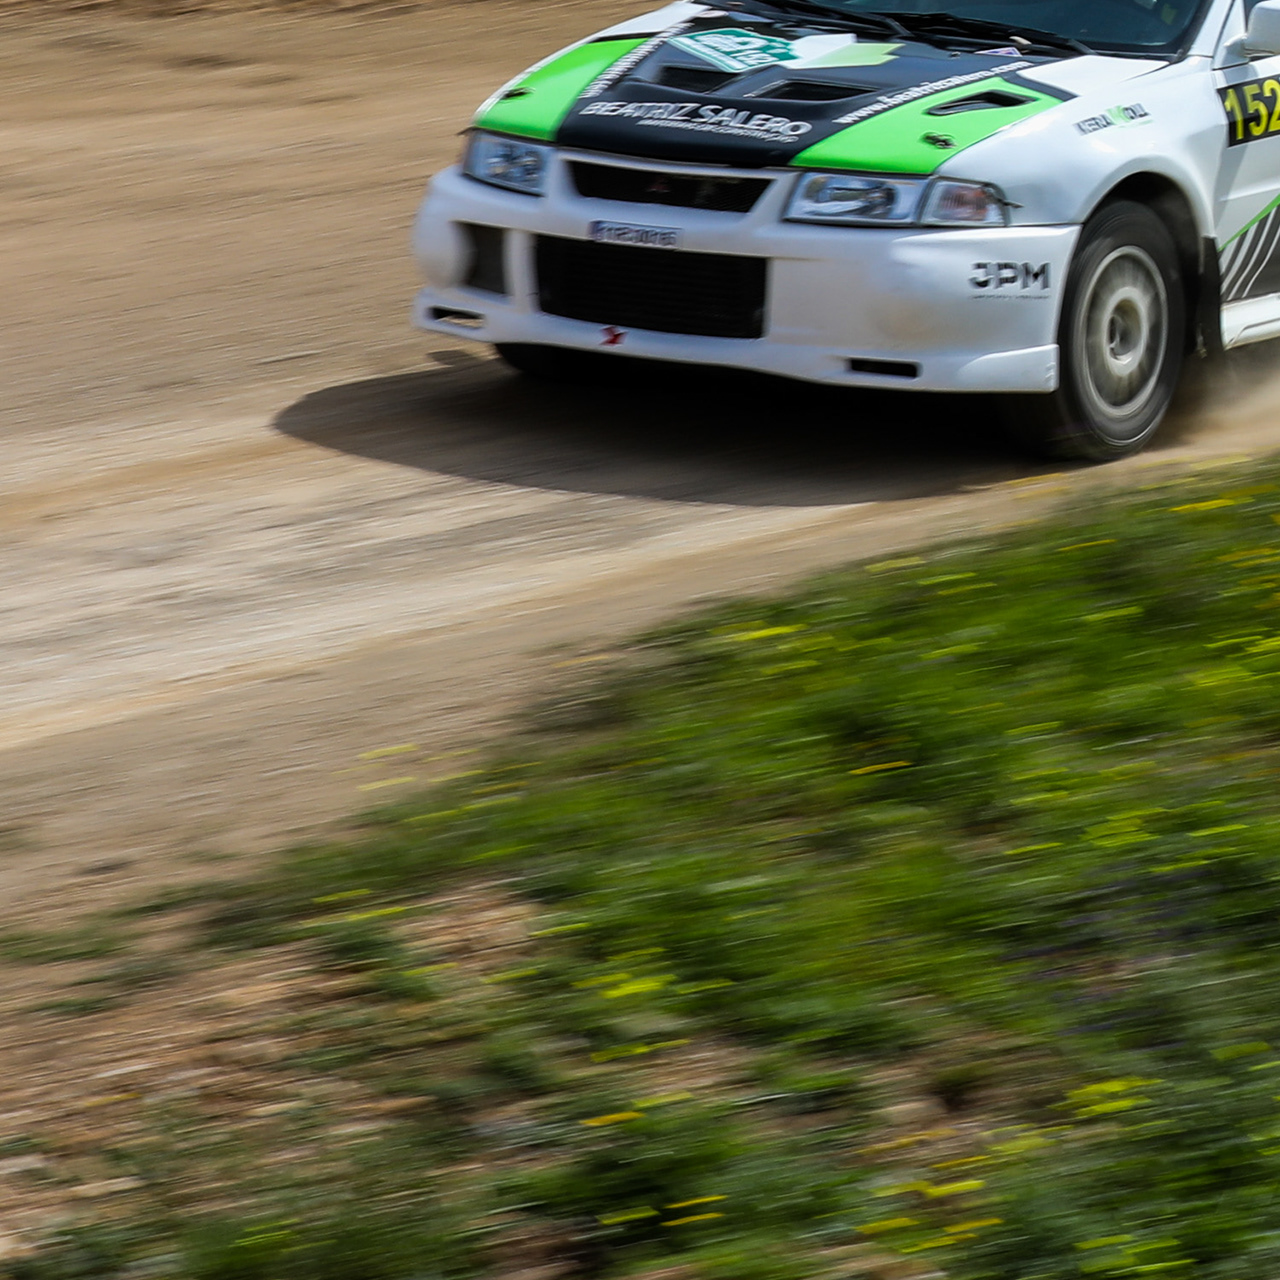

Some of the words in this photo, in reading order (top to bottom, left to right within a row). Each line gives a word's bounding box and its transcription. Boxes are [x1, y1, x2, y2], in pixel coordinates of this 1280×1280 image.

[578, 101, 700, 120] BEATRIZ
[697, 105, 813, 136] SALERO
[967, 261, 1051, 290] JPM
